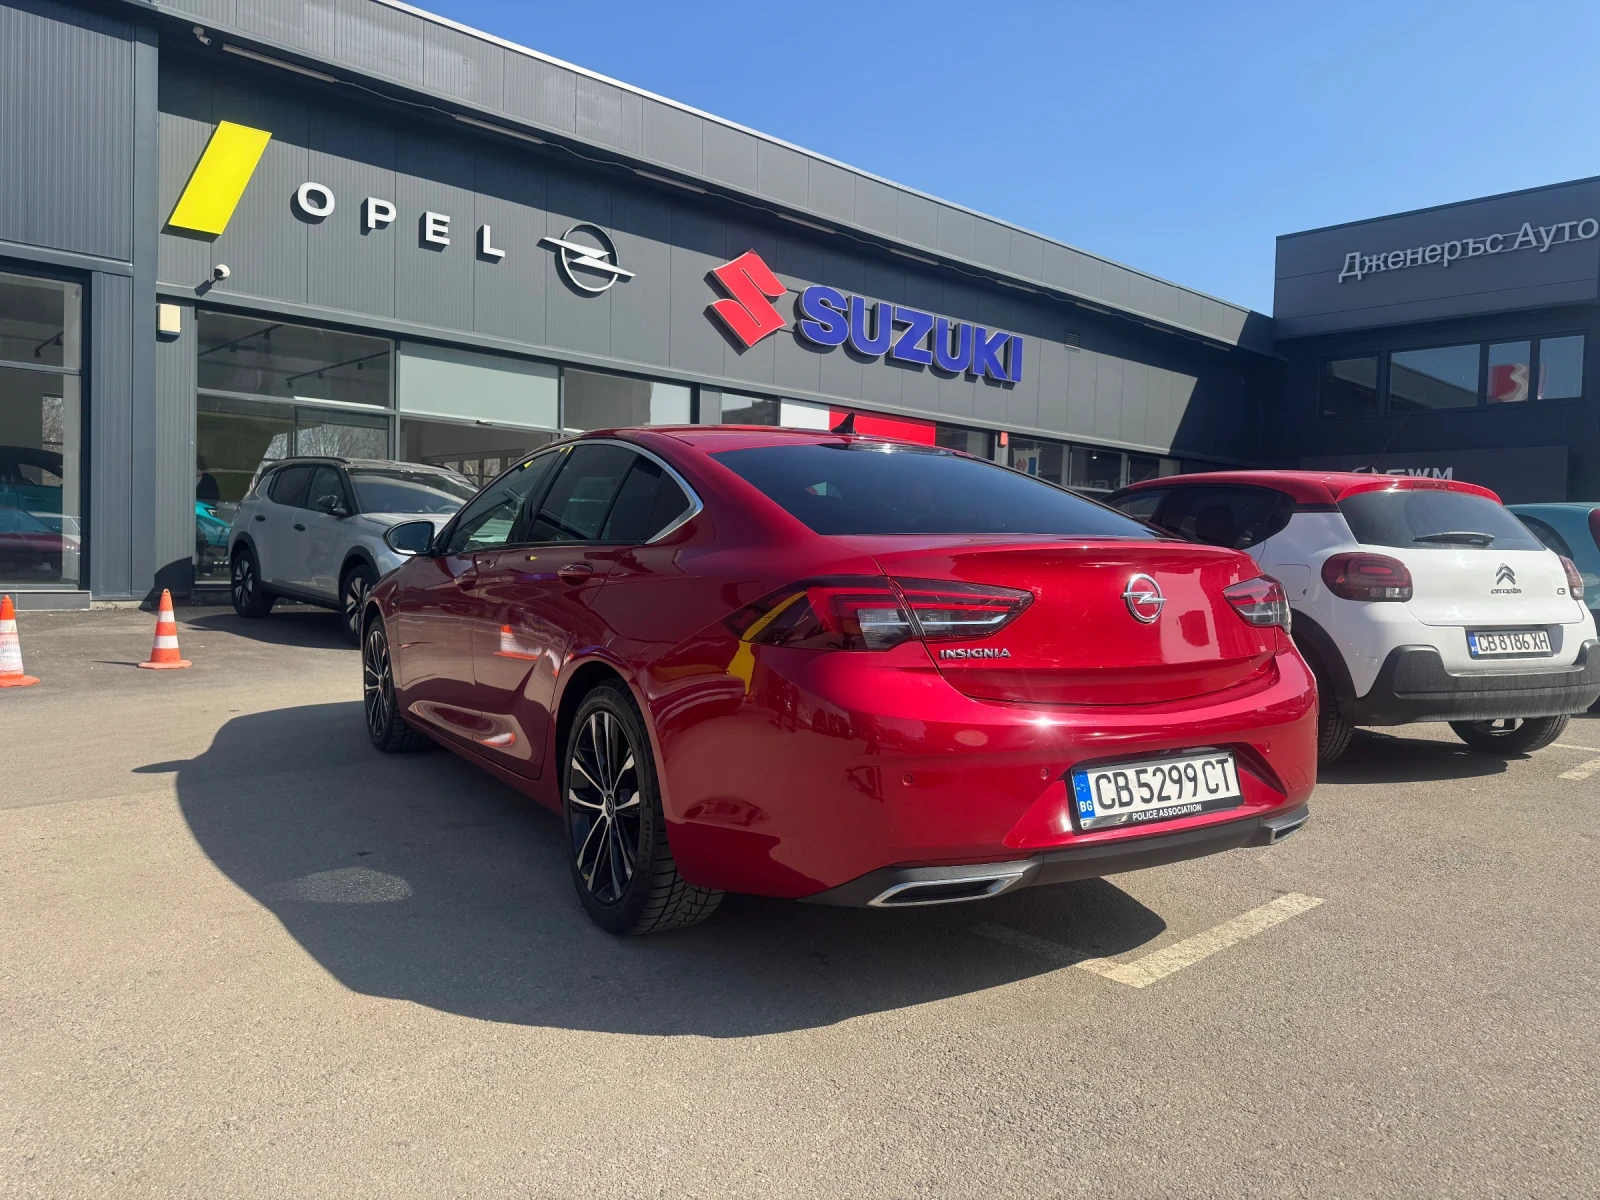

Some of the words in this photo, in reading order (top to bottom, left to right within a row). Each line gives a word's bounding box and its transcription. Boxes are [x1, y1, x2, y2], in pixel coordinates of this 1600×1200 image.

[298, 181, 506, 258] OPEL
[1338, 233, 1504, 284] Дженеръс
[1513, 218, 1599, 253] Ауто
[800, 284, 1024, 384] SUZUKI
[940, 648, 1012, 659] INSIGNIA
[1079, 801, 1093, 812] BG
[1132, 808, 1158, 821] POLICE
[1159, 804, 1202, 818] ASSOCIATION
